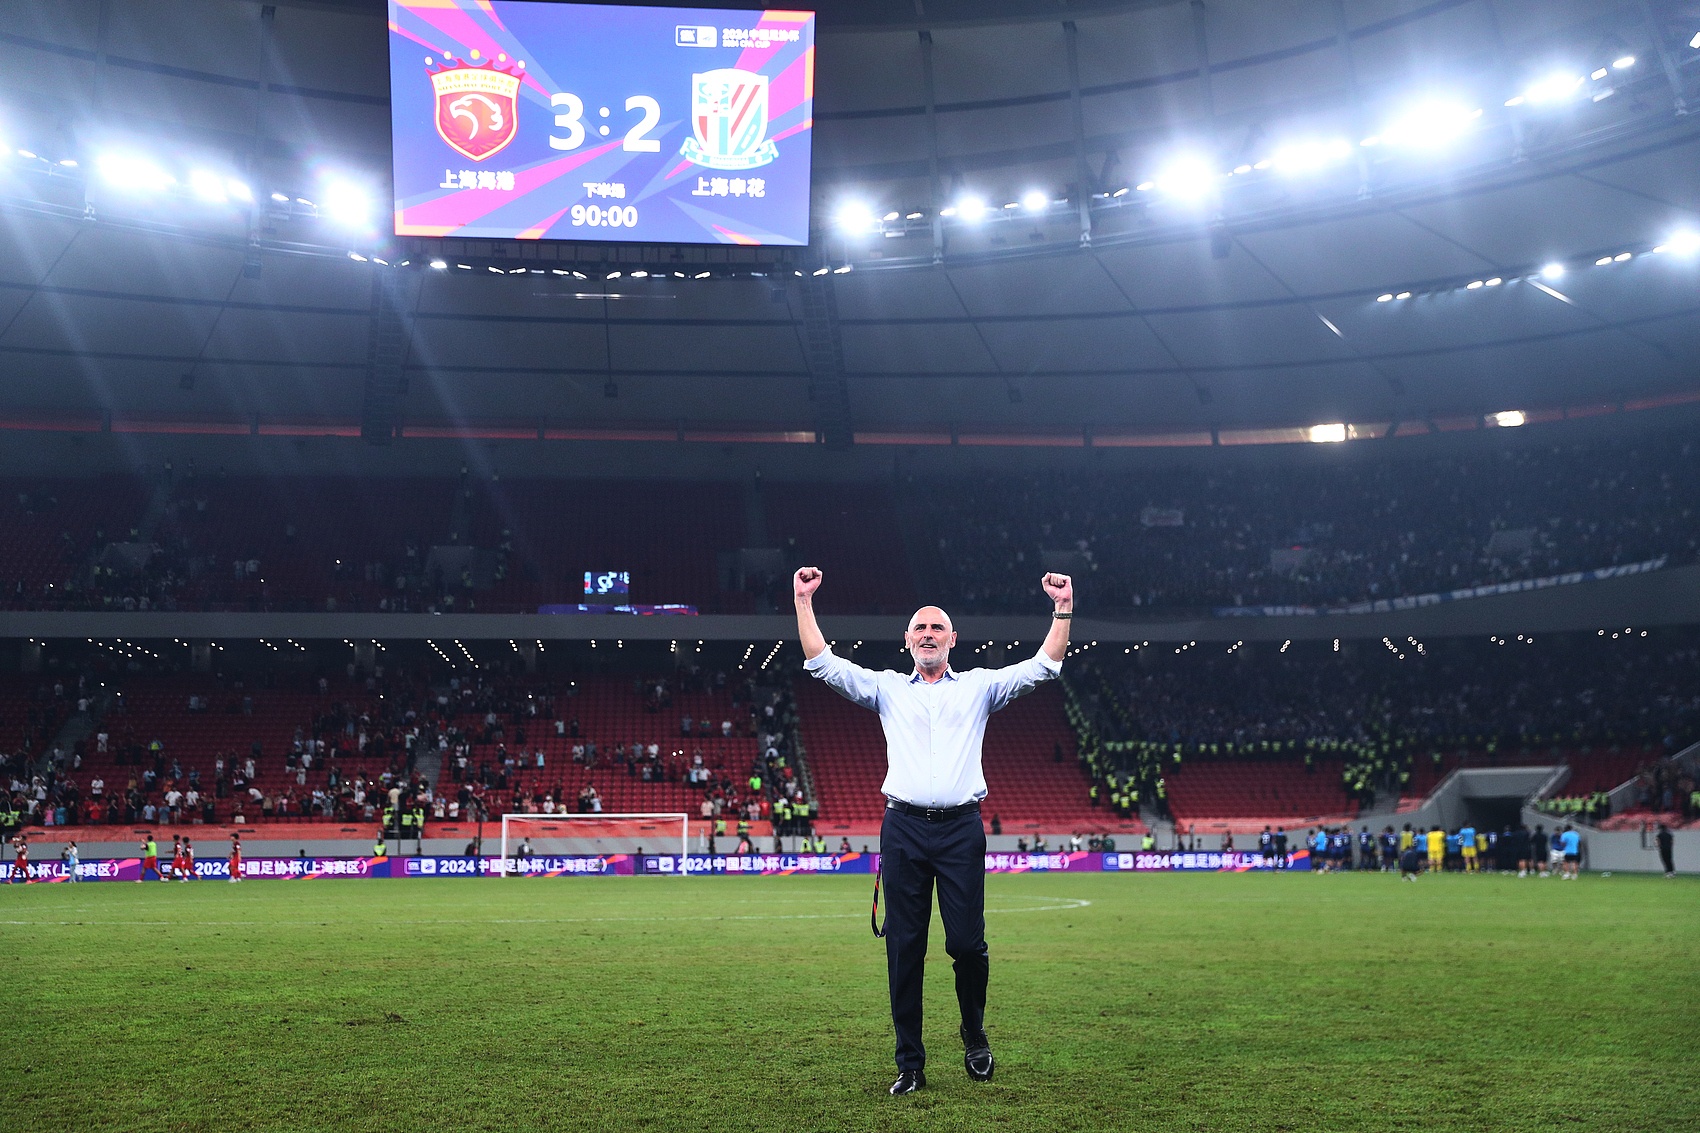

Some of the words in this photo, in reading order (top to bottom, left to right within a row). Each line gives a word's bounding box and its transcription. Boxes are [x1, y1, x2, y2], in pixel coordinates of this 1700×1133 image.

[439, 169, 515, 190] 上海海港
[691, 177, 766, 197] 上海申花
[582, 182, 626, 198] 下半场
[571, 204, 638, 227] 90:00
